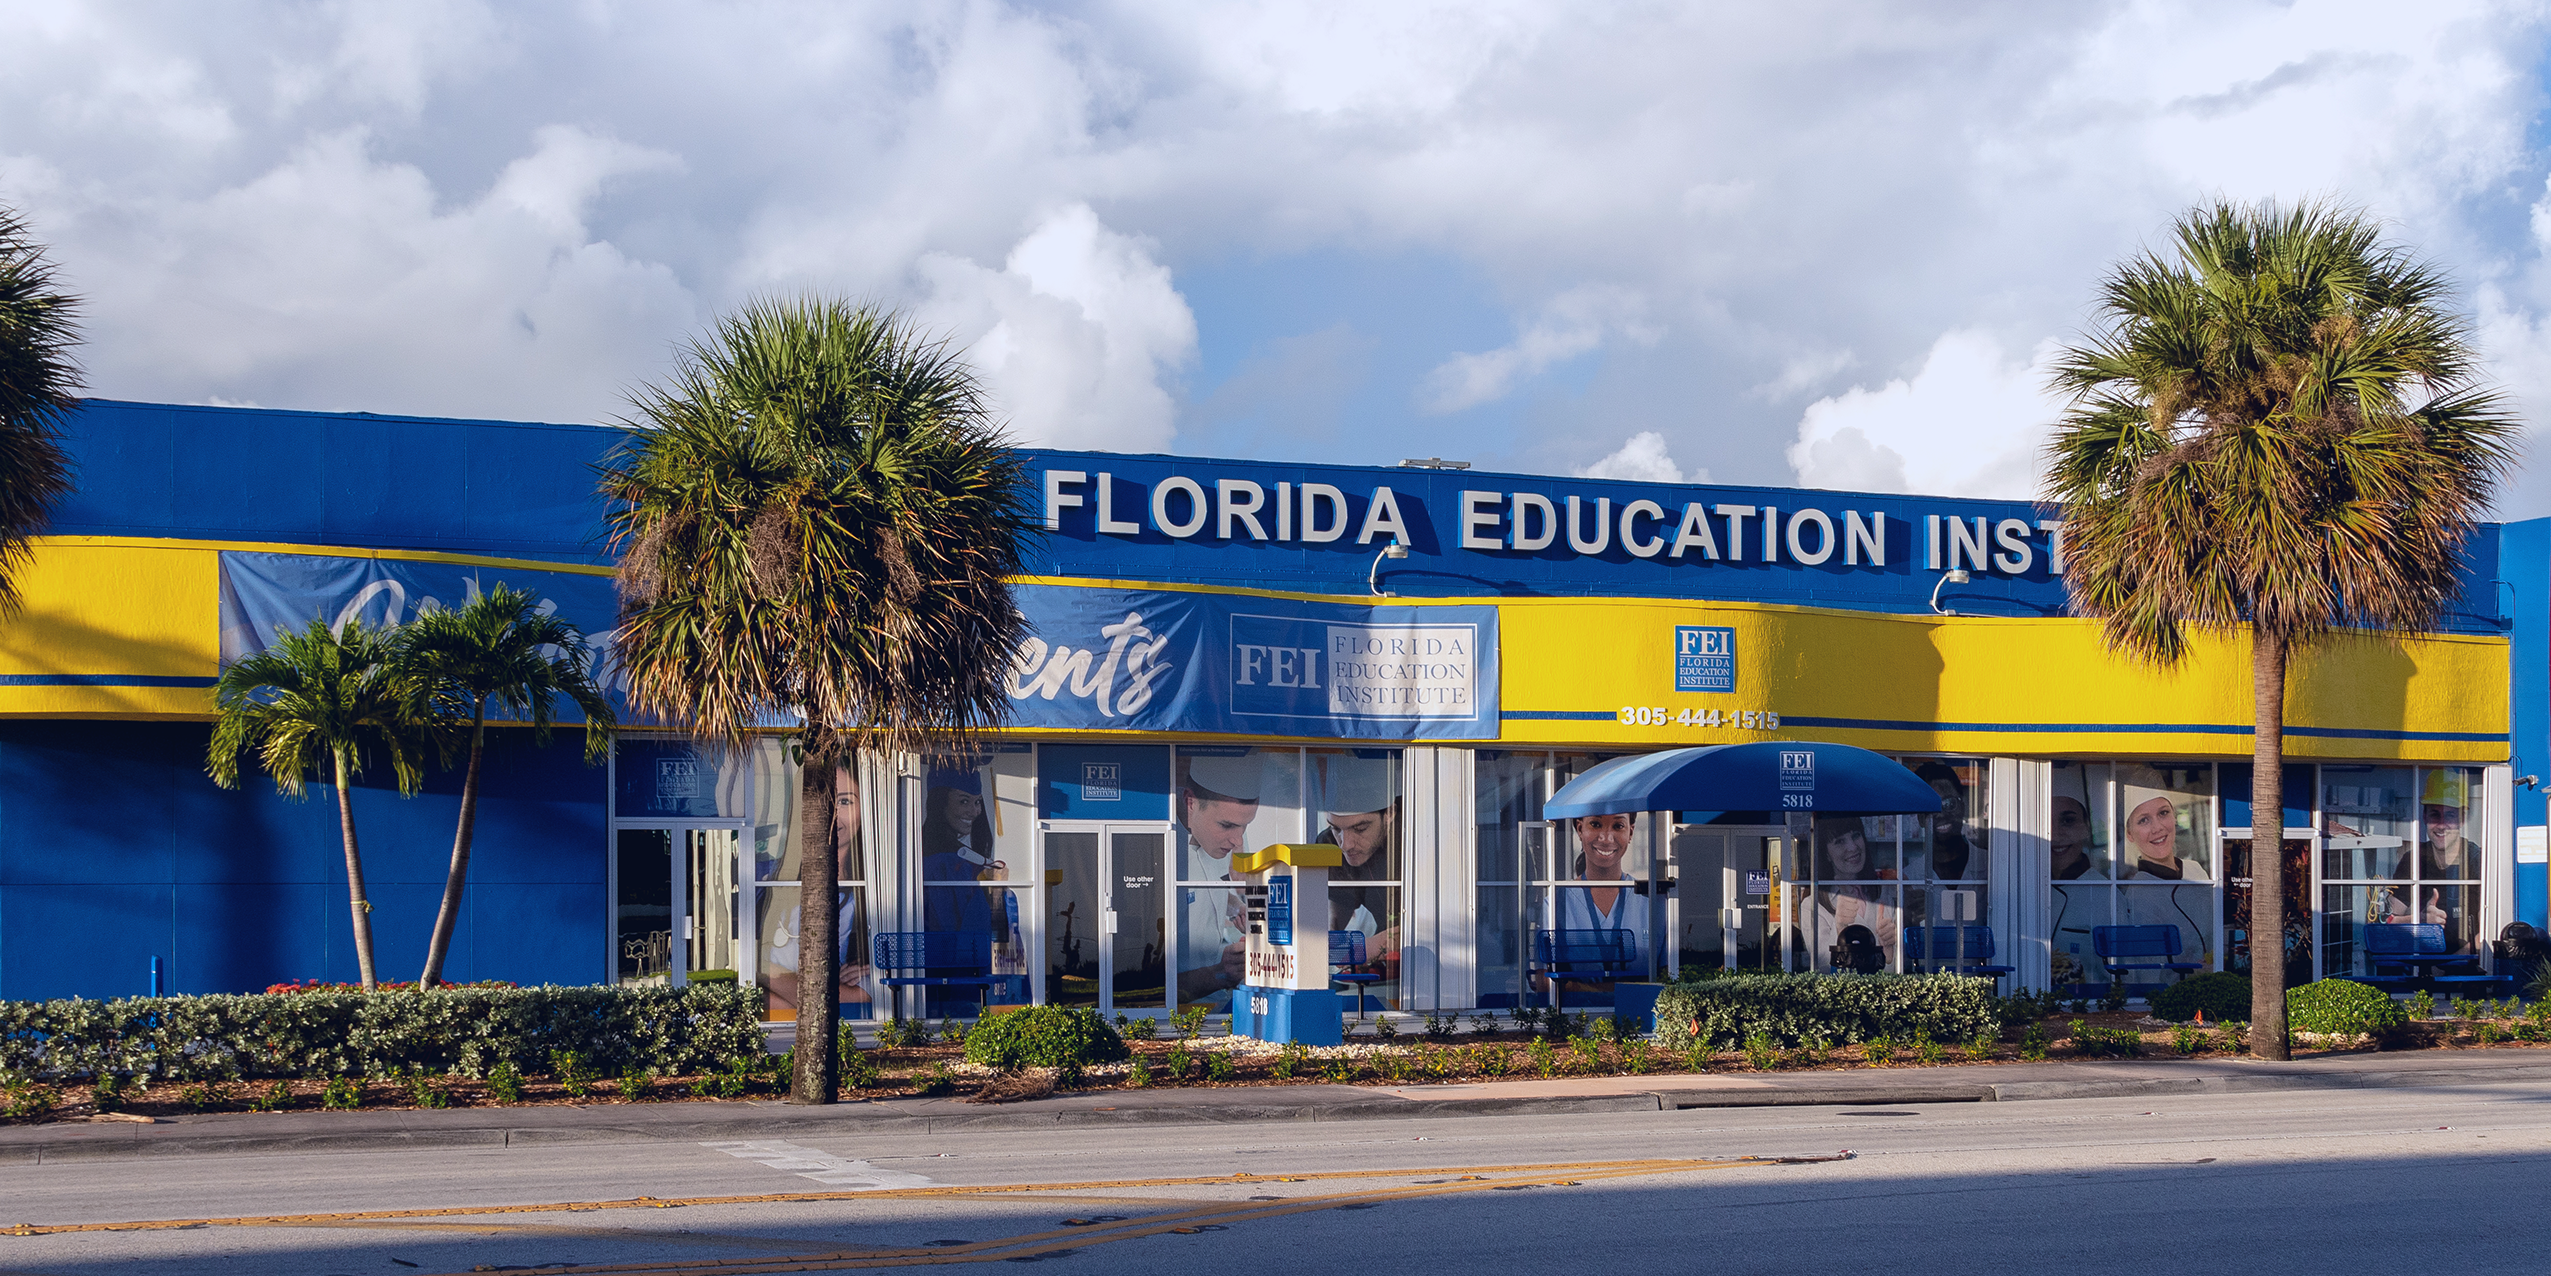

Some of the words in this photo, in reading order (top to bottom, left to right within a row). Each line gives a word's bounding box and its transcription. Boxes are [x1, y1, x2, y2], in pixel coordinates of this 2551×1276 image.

[1043, 469, 1412, 546] FLORIDA
[1458, 490, 1885, 567] EDUCATION
[1335, 636, 1465, 656] FLORIDA
[1679, 630, 1731, 656] FEI
[1236, 644, 1322, 689] FEI
[1336, 662, 1466, 680] EDUCATION
[1679, 657, 1731, 668] FLORIDA
[1679, 667, 1730, 677] EDUCATION
[1679, 676, 1731, 686] INSTITUTE
[1337, 685, 1466, 705] INSTITUTE
[1620, 705, 1780, 731] 305-444-1515
[661, 762, 696, 775] FEI
[1781, 753, 1812, 769] FEI
[1085, 765, 1117, 779] FEI
[1782, 794, 1813, 808] 5818
[1268, 883, 1288, 904] FEI
[1249, 952, 1294, 979] 305-444-1515
[1250, 997, 1268, 1016] 5818
